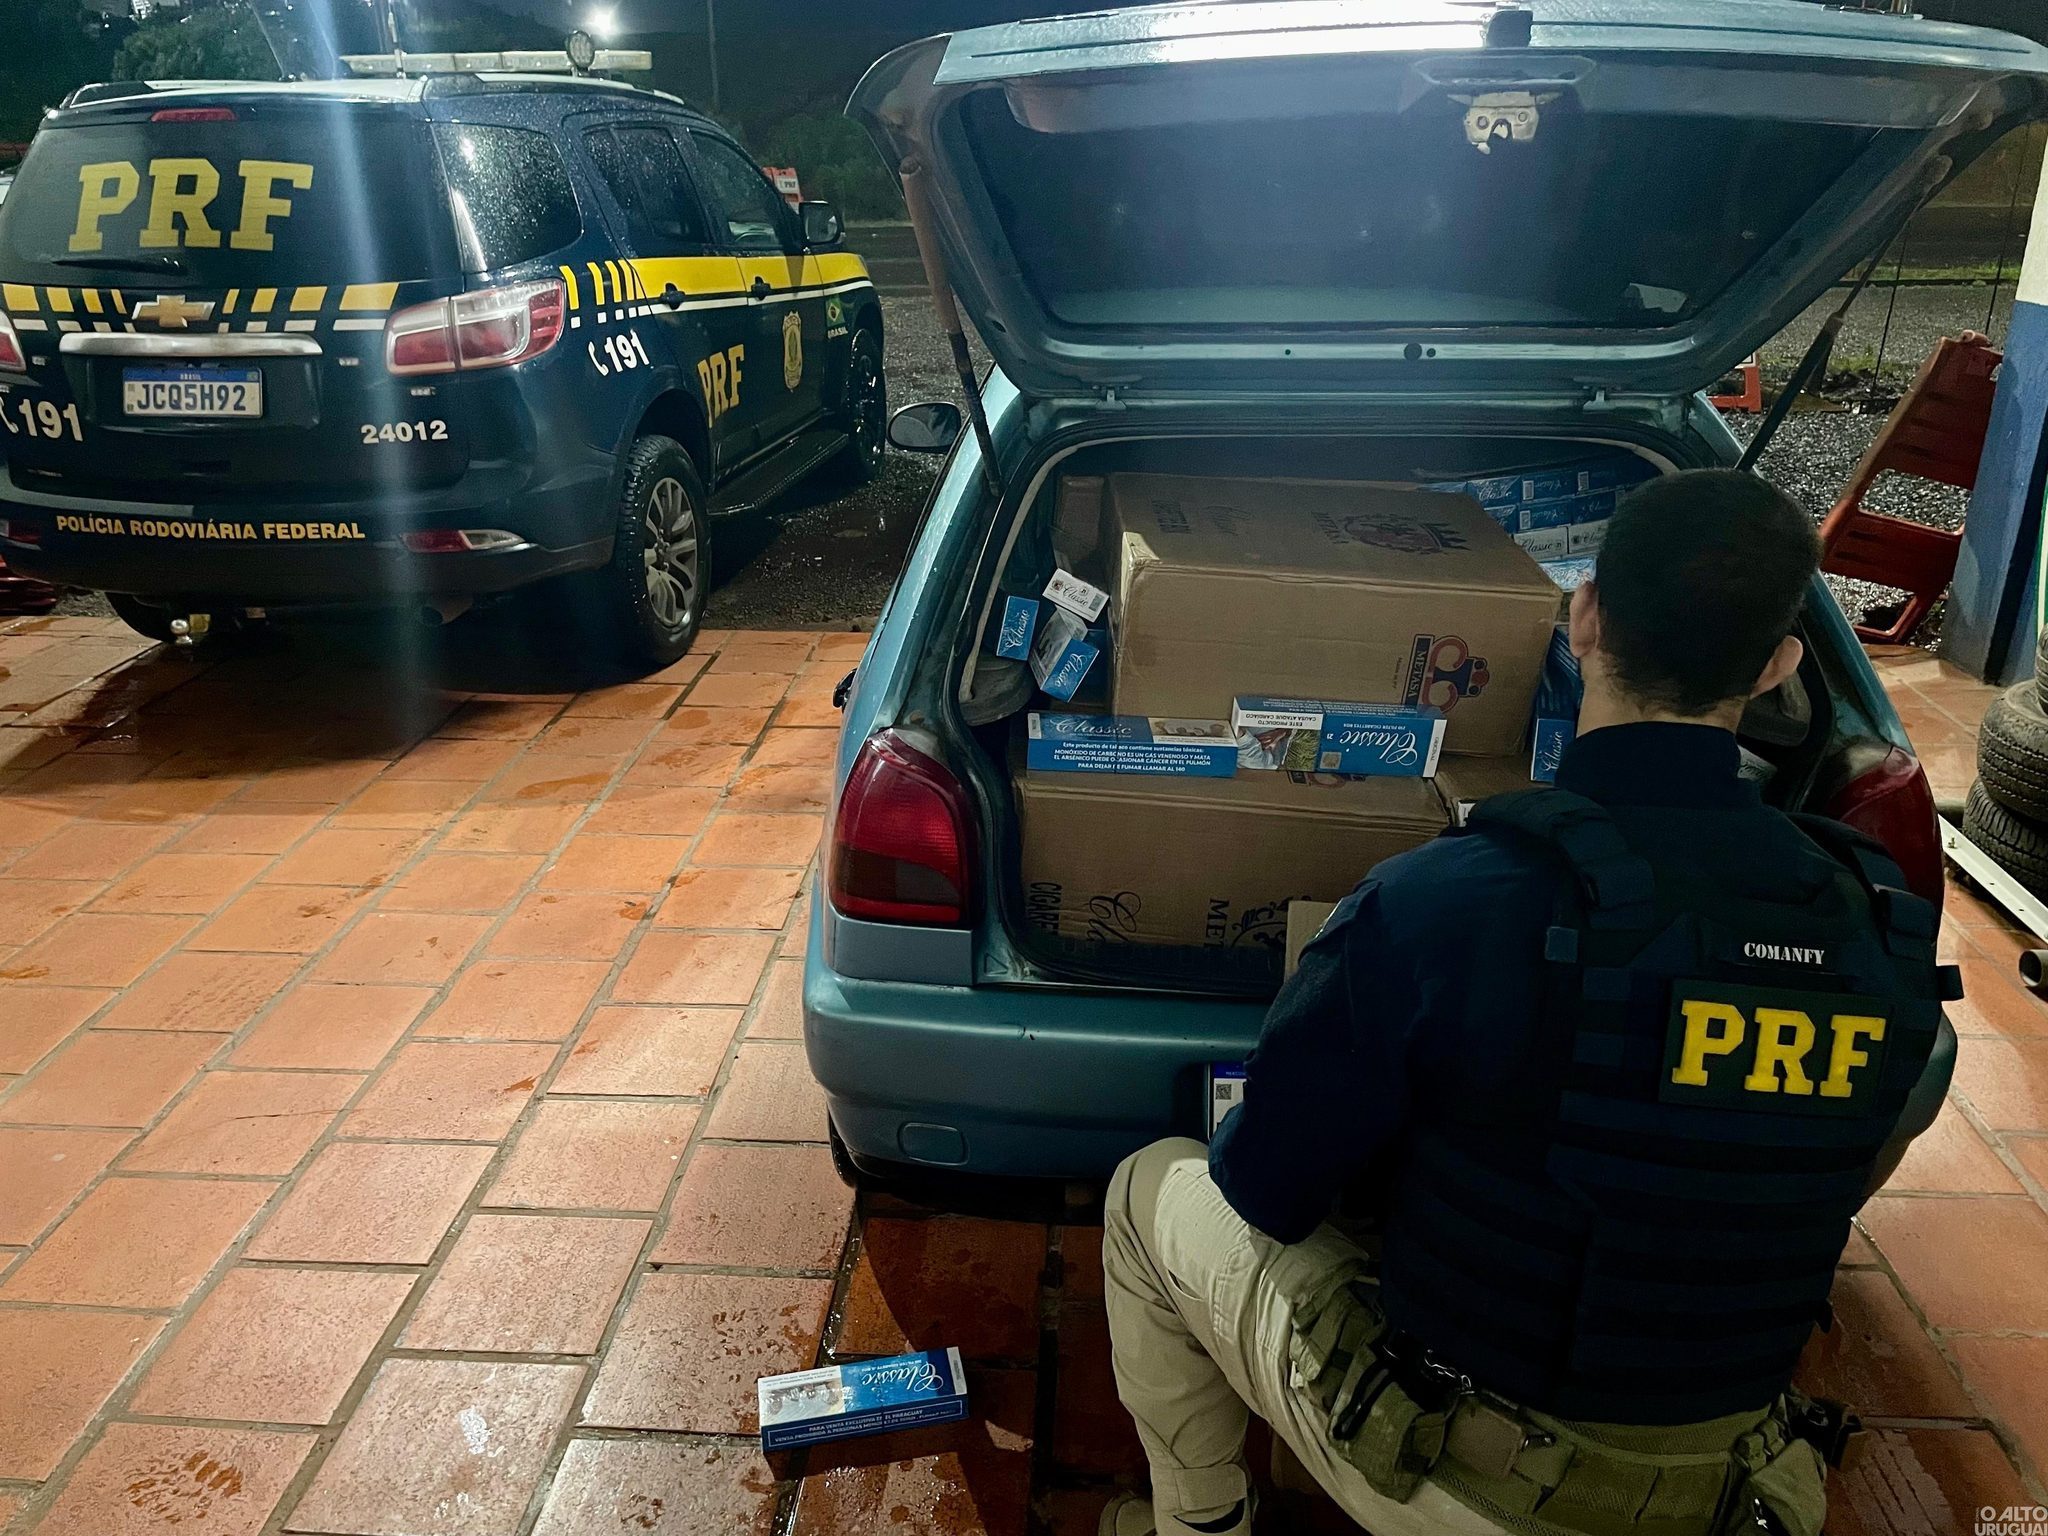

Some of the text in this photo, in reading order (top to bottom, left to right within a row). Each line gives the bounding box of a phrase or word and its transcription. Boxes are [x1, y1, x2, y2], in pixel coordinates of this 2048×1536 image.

[69, 157, 314, 252] PRF
[604, 329, 650, 373] 191
[137, 383, 247, 411] JCQ5H92
[697, 343, 744, 429] PRF
[19, 398, 83, 442] 191
[361, 419, 449, 444] 24012
[56, 513, 366, 540] POLÍCIA RODOVIÁRIA FEDERAL
[1062, 583, 1088, 607] Classic
[1005, 609, 1030, 649] Classic
[1055, 652, 1088, 688] Classic
[1408, 650, 1427, 698] METASA
[1050, 718, 1133, 735] Classic
[1054, 748, 1089, 756] MONÓXIDO
[1075, 742, 1101, 750] producto
[1145, 757, 1169, 765] CÁNCER
[1340, 730, 1418, 766] Classic
[1541, 731, 1563, 771] Classic
[1203, 899, 1230, 948] MET
[1743, 942, 1825, 965] COMANFY
[1671, 999, 1886, 1098] PRF
[861, 1361, 944, 1392] Classic
[826, 1422, 845, 1430] VENTA
[845, 1416, 876, 1427] EXCLUSIVA
[892, 1409, 923, 1419] PARAGUAY
[832, 1424, 863, 1434] PERSONAS
